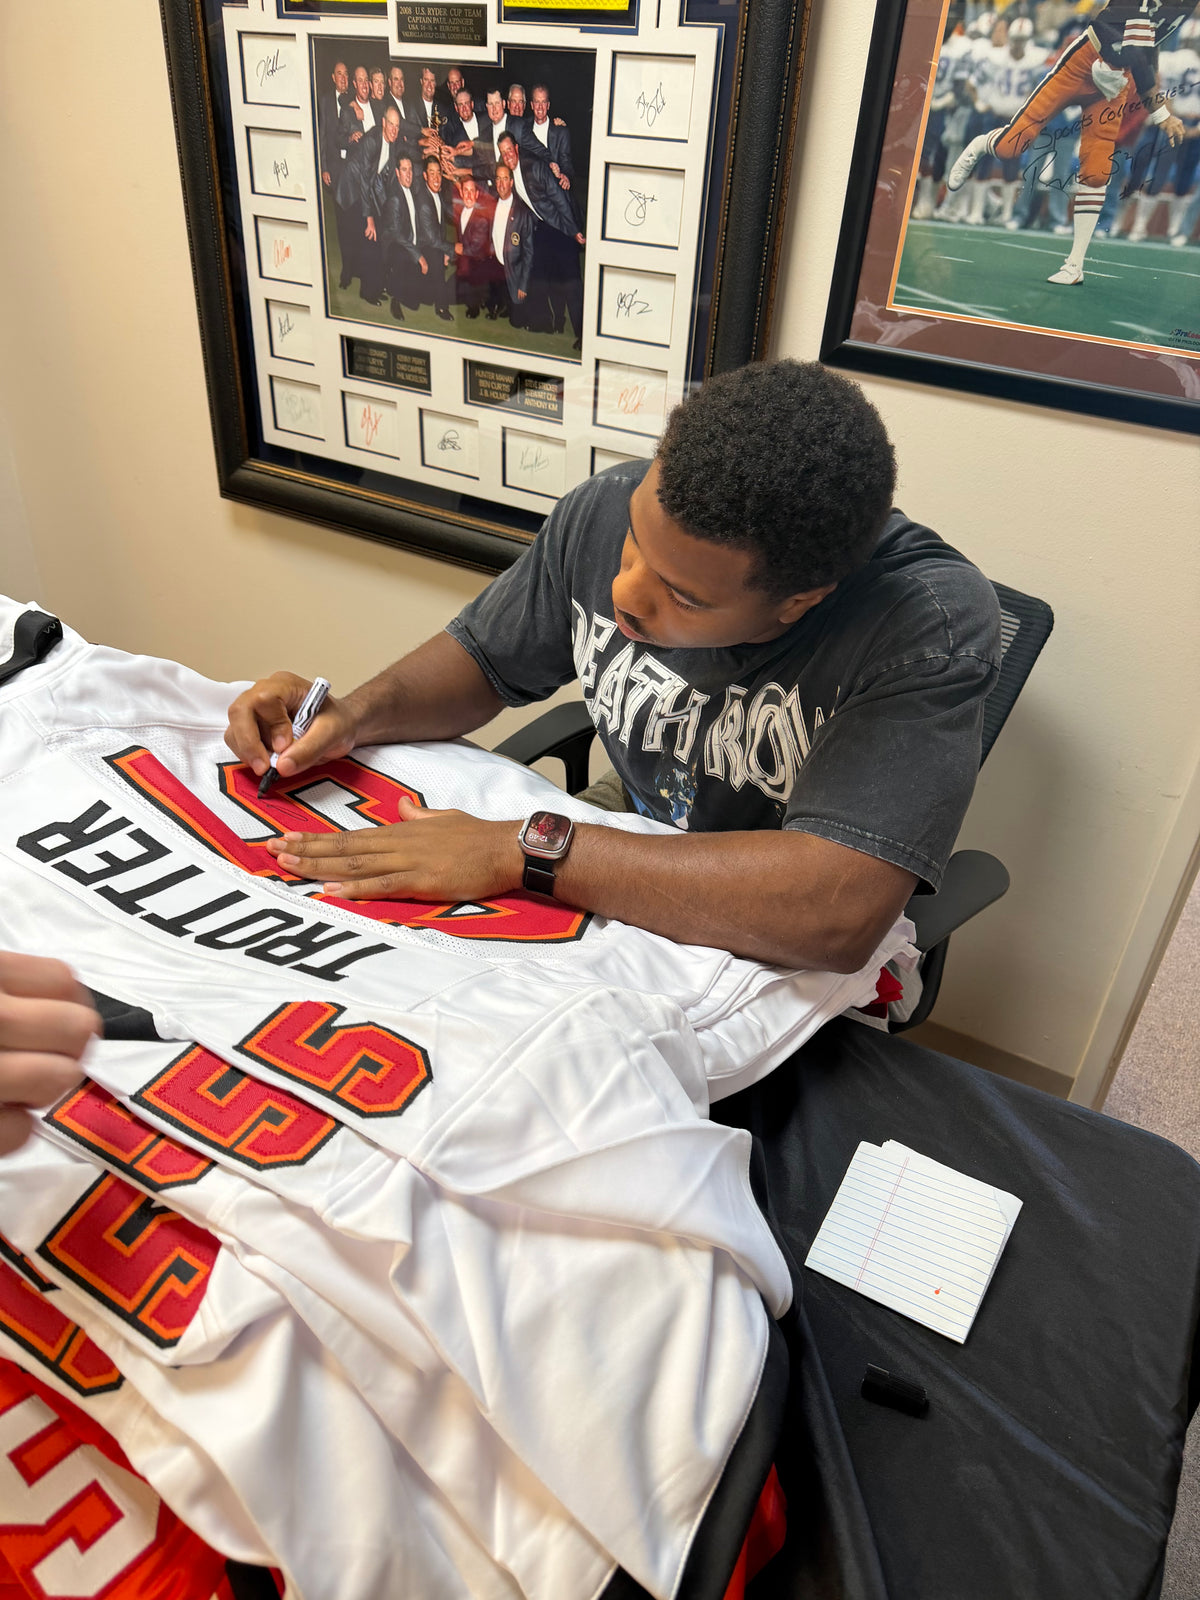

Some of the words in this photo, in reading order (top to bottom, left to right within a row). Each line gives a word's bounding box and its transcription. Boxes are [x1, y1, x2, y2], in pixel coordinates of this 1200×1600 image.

[407, 16, 433, 24] CAPTAIN
[415, 7, 426, 16] U.S.
[427, 7, 448, 16] RYDER
[449, 8, 462, 17] CUP
[464, 8, 482, 18] TEAM
[16, 799, 398, 982] TROTTER
[232, 999, 434, 1120] 5
